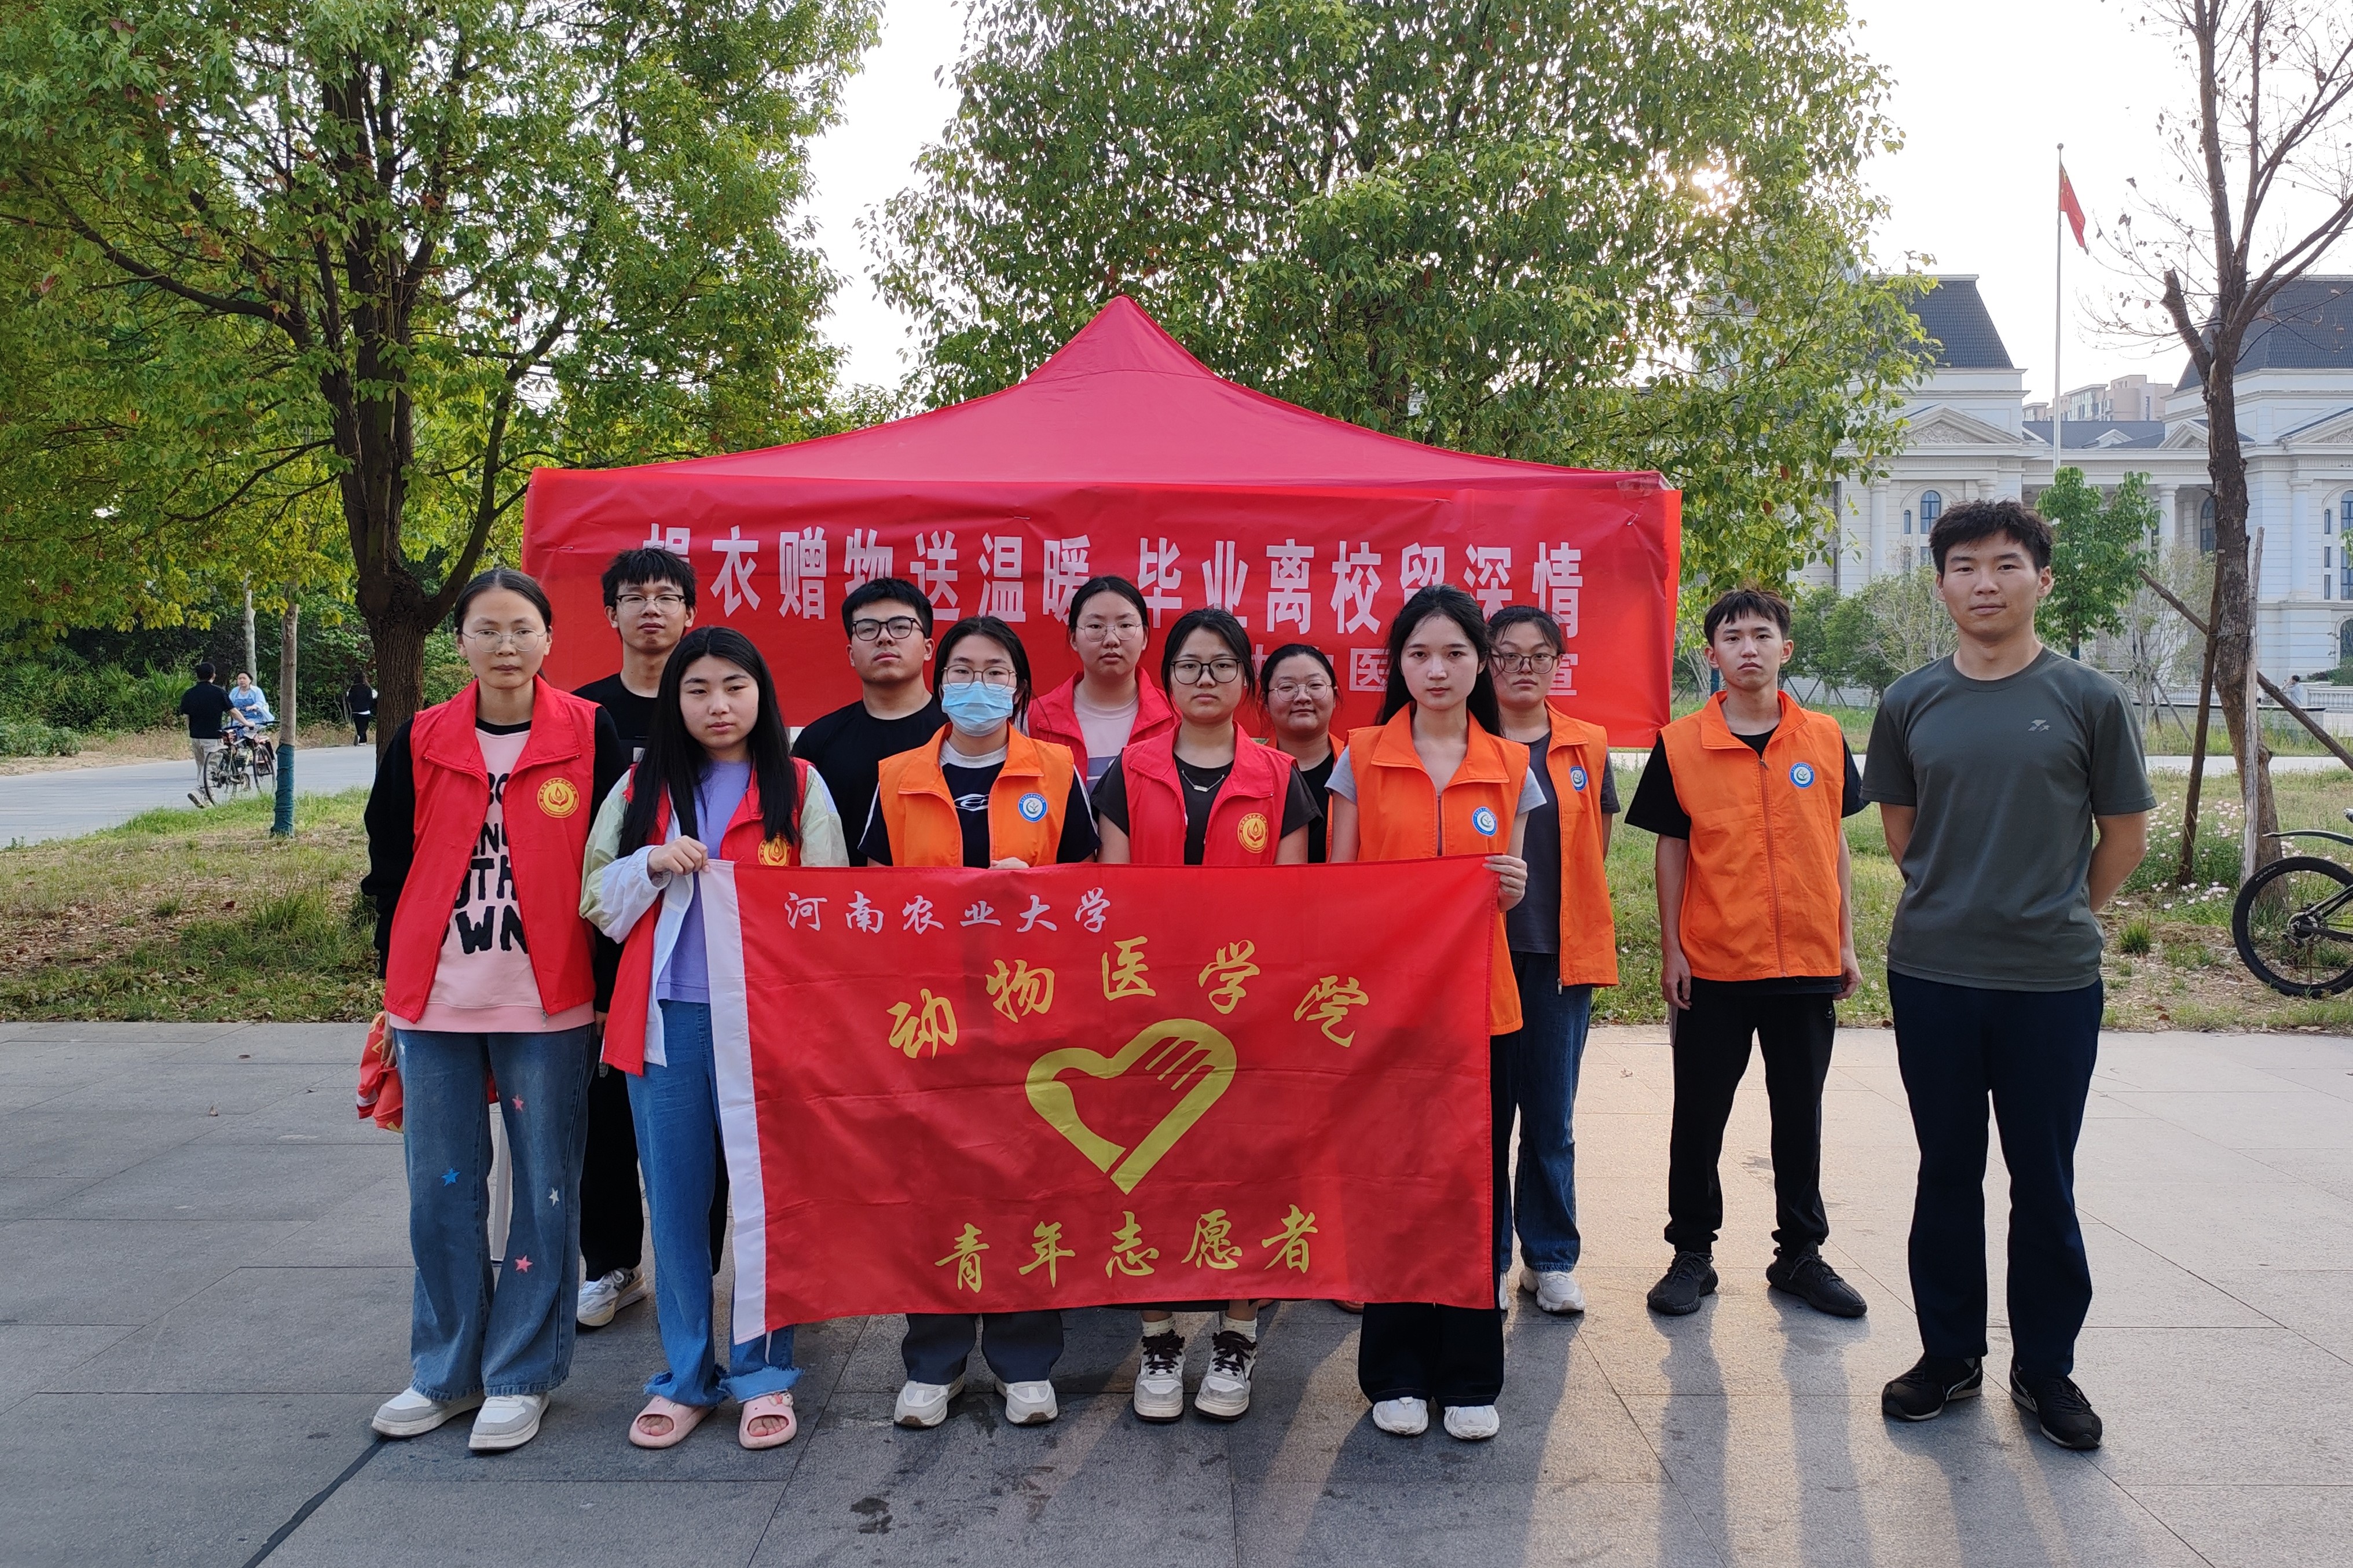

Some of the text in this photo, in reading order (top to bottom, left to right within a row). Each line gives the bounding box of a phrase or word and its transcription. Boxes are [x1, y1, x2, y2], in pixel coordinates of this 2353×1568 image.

[1137, 537, 1584, 638] 毕业离校留深情
[441, 904, 530, 955] WN
[784, 887, 1111, 934] 河南农业大学
[886, 935, 1369, 1060] 动物医学院
[934, 1204, 1318, 1294] 青年志愿者
